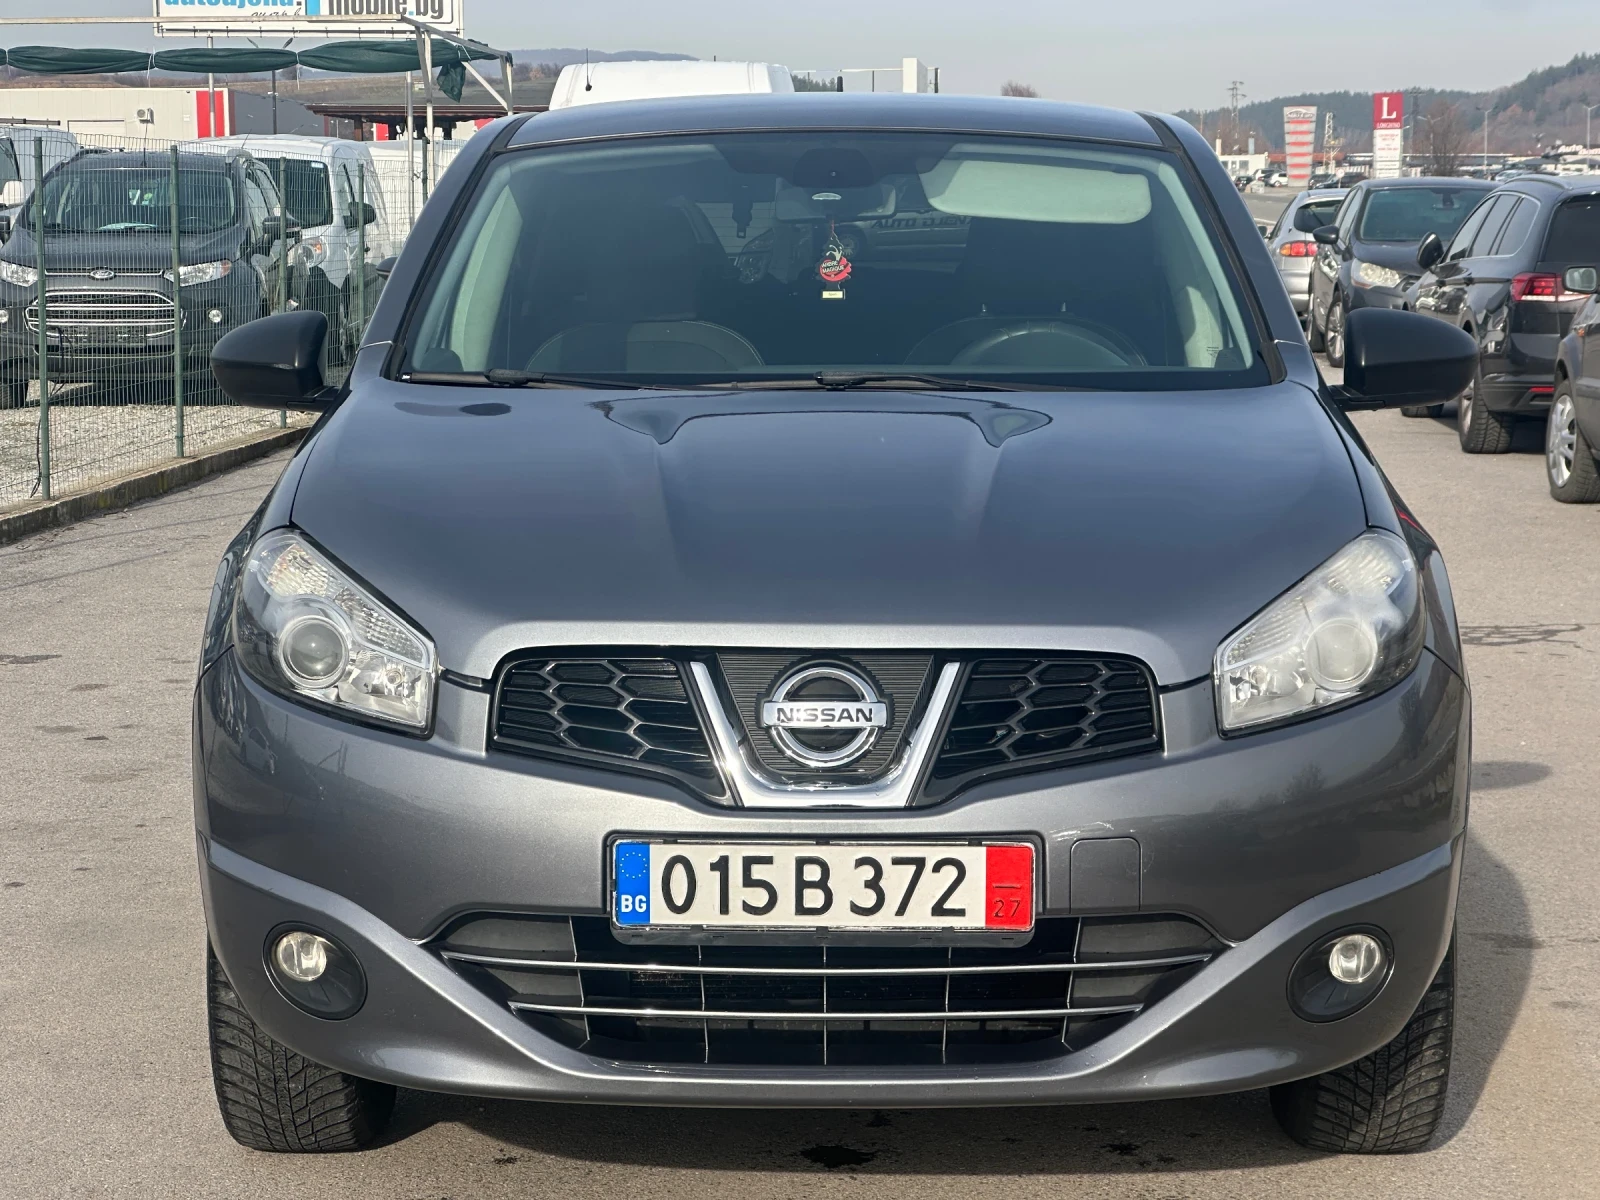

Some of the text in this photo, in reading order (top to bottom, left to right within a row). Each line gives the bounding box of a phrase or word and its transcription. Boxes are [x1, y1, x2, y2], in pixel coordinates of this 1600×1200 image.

[1381, 97, 1397, 119] L
[871, 217, 917, 229] AUTO
[776, 707, 873, 723] NISSAN
[621, 894, 647, 914] BG
[994, 898, 1021, 918] 27
